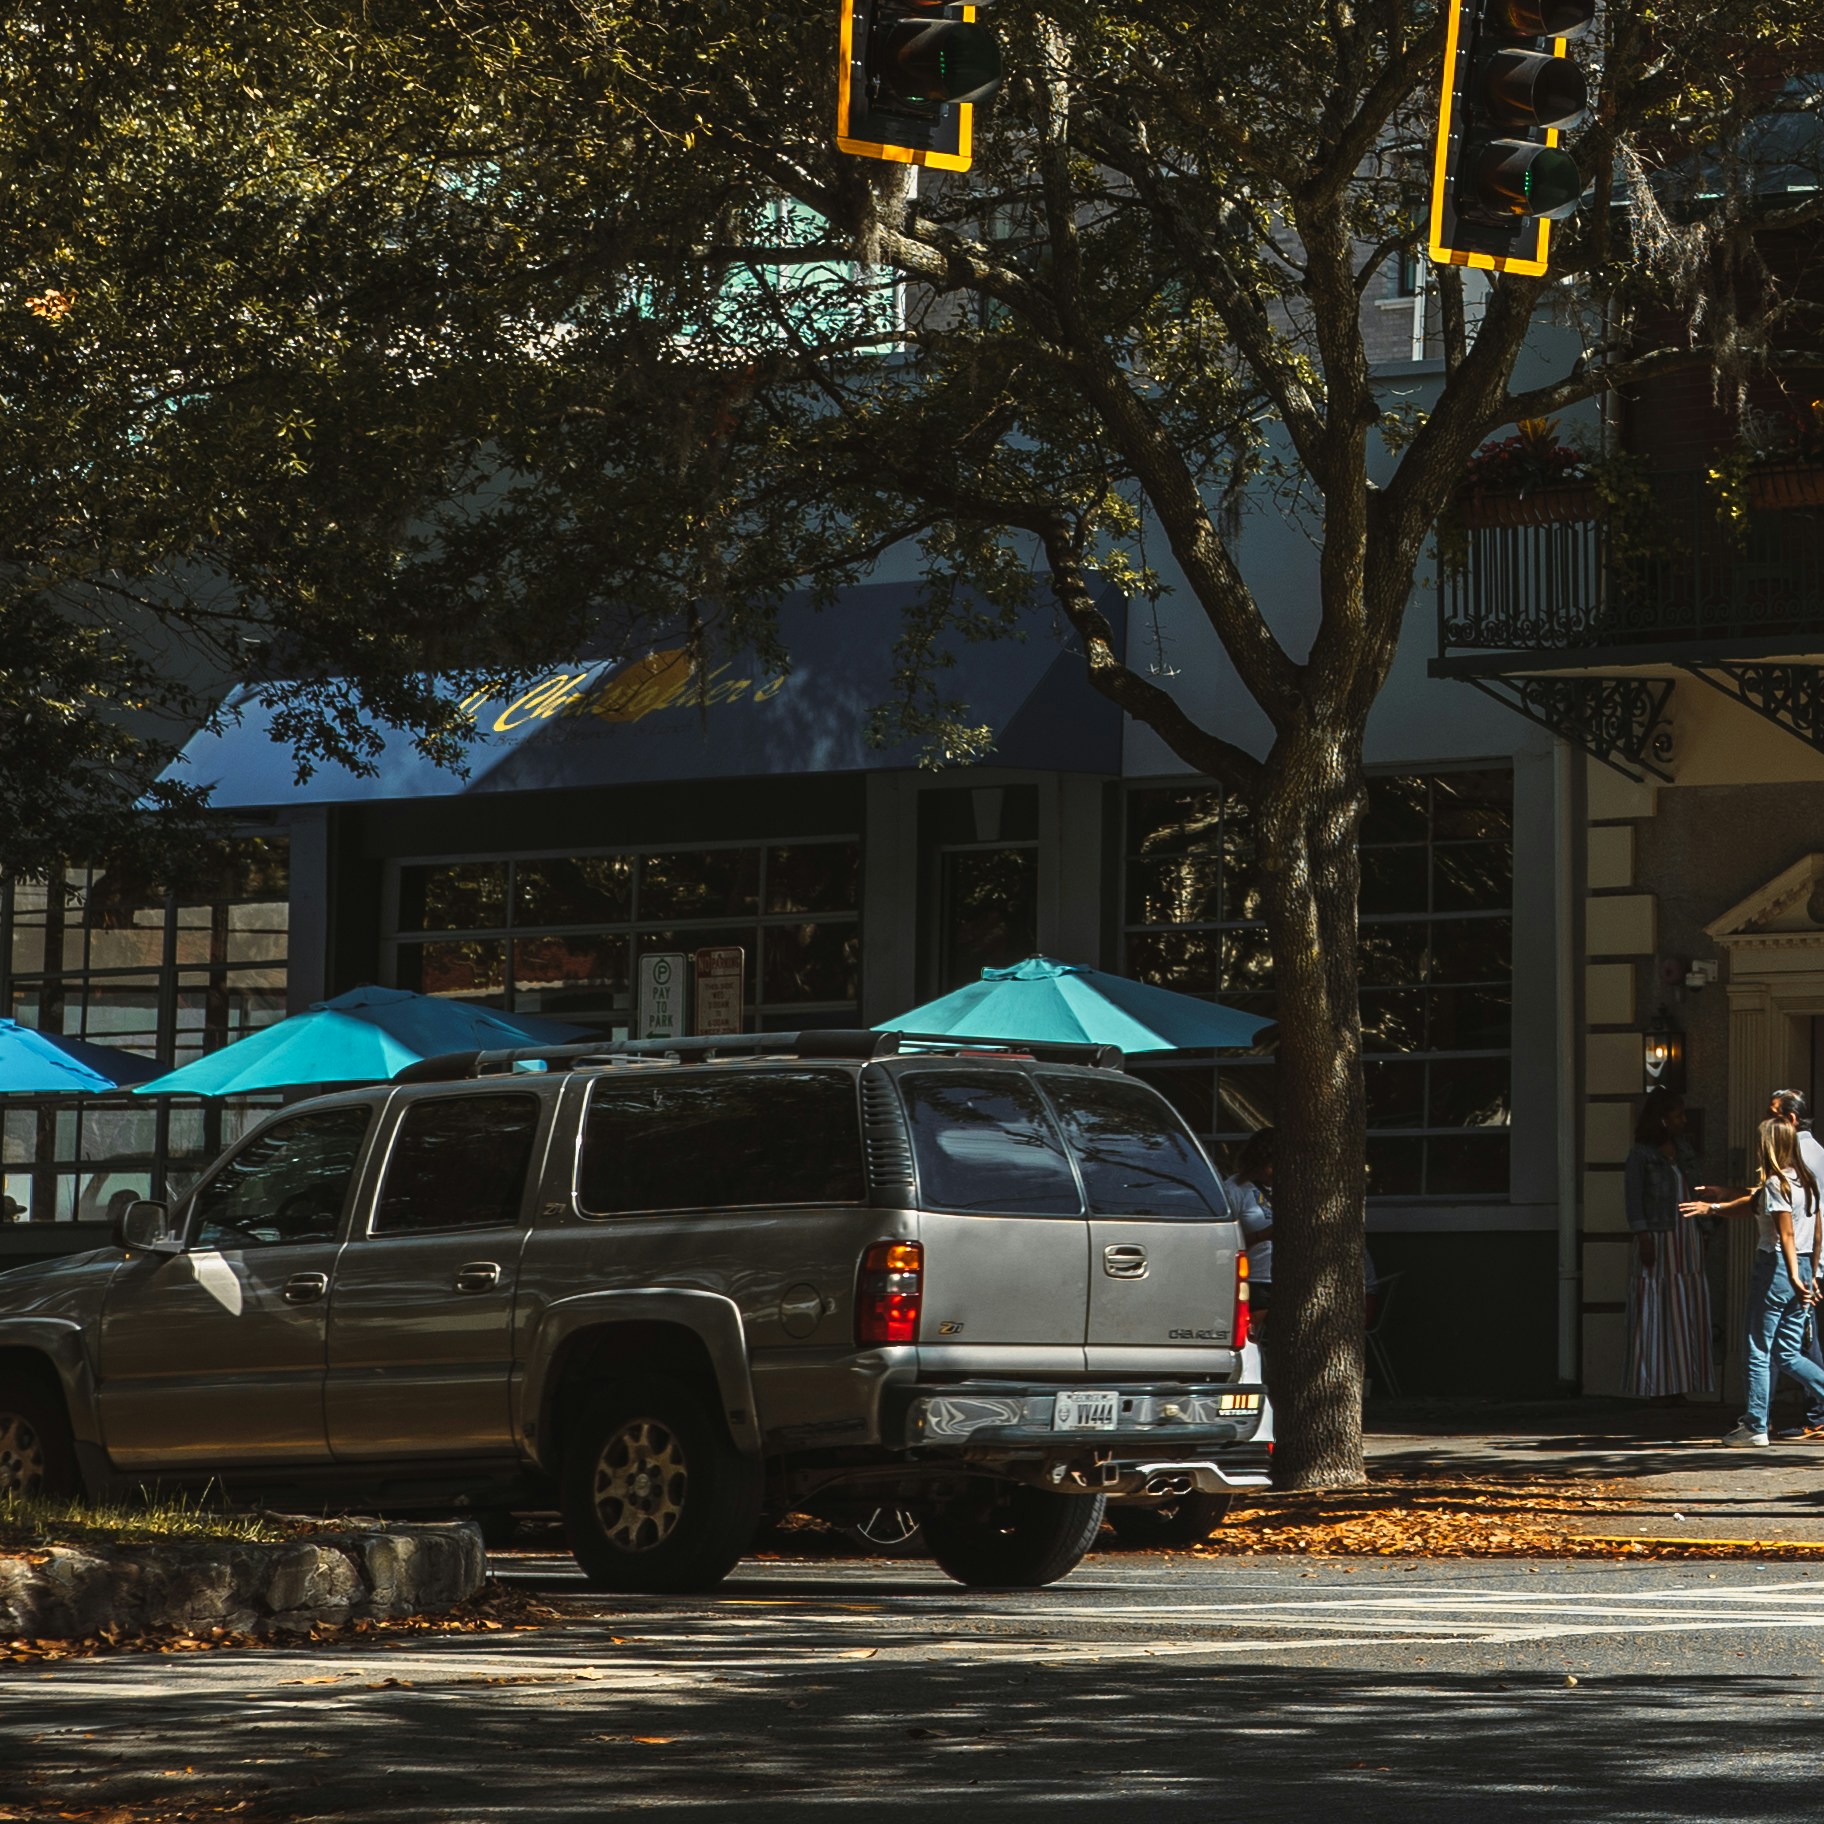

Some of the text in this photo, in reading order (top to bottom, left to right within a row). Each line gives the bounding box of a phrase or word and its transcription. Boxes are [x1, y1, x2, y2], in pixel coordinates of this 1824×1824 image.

[653, 987, 671, 1000] PAY
[656, 1001, 667, 1013] TO
[649, 1014, 674, 1027] PARK
